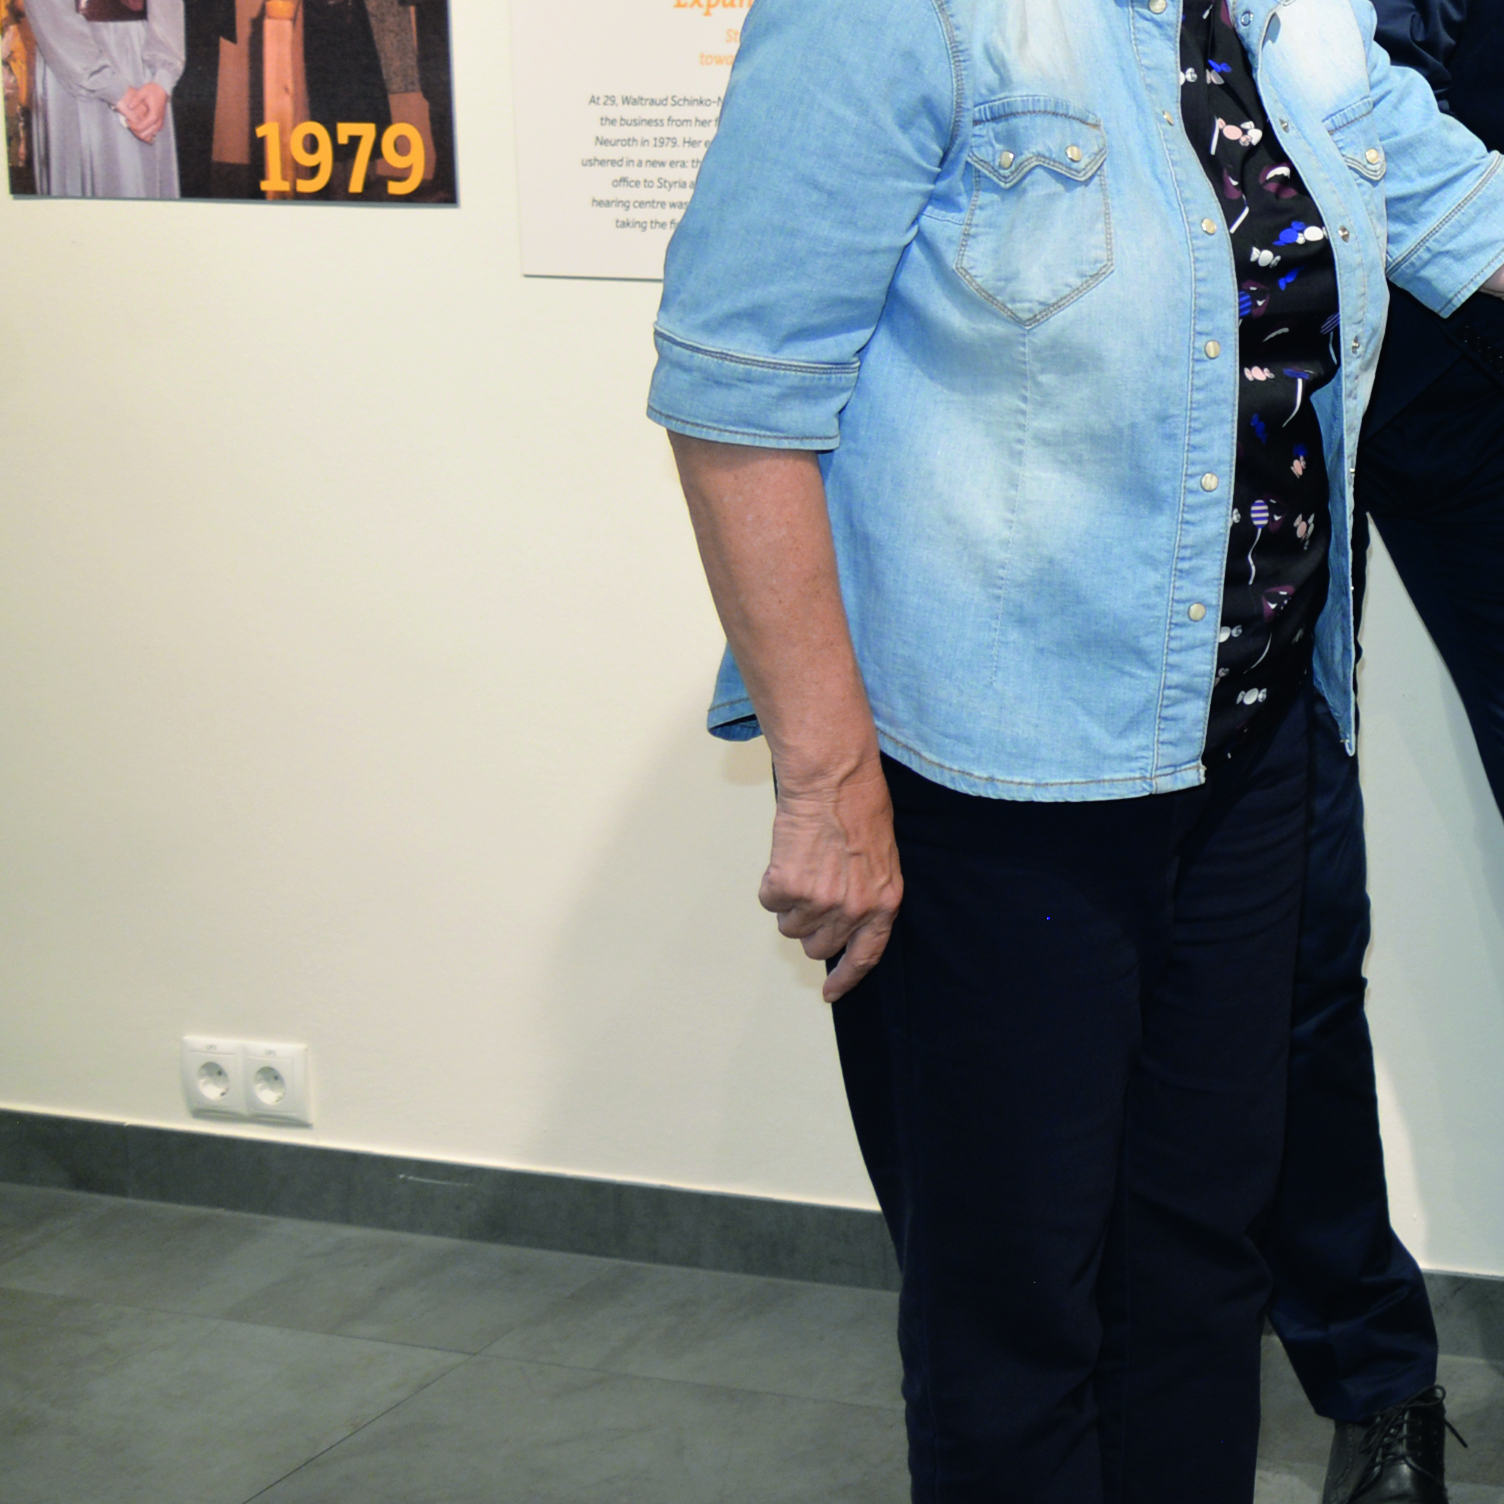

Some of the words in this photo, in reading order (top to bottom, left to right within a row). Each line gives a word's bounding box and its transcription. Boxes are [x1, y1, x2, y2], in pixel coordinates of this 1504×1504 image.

[700, 52, 733, 66] towa
[589, 95, 600, 106] At
[603, 95, 618, 106] 29,
[622, 96, 668, 106] Waltraud
[670, 96, 723, 106] Schinko-N
[600, 117, 617, 126] the
[620, 117, 664, 126] business
[667, 116, 692, 127] from
[695, 117, 710, 127] her
[595, 136, 638, 146] Neuroth
[640, 137, 649, 146] in
[653, 137, 679, 148] 1979.
[682, 138, 702, 148] Her
[256, 121, 425, 195] 1979
[582, 157, 623, 166] ushered
[626, 158, 634, 167] in
[645, 160, 666, 168] new
[669, 160, 688, 168] era:
[612, 176, 640, 188] office
[644, 178, 654, 188] to
[656, 178, 686, 191] Styria
[592, 198, 630, 211] hearing
[633, 200, 666, 208] centre
[615, 220, 647, 232] taking
[650, 220, 667, 229] the
